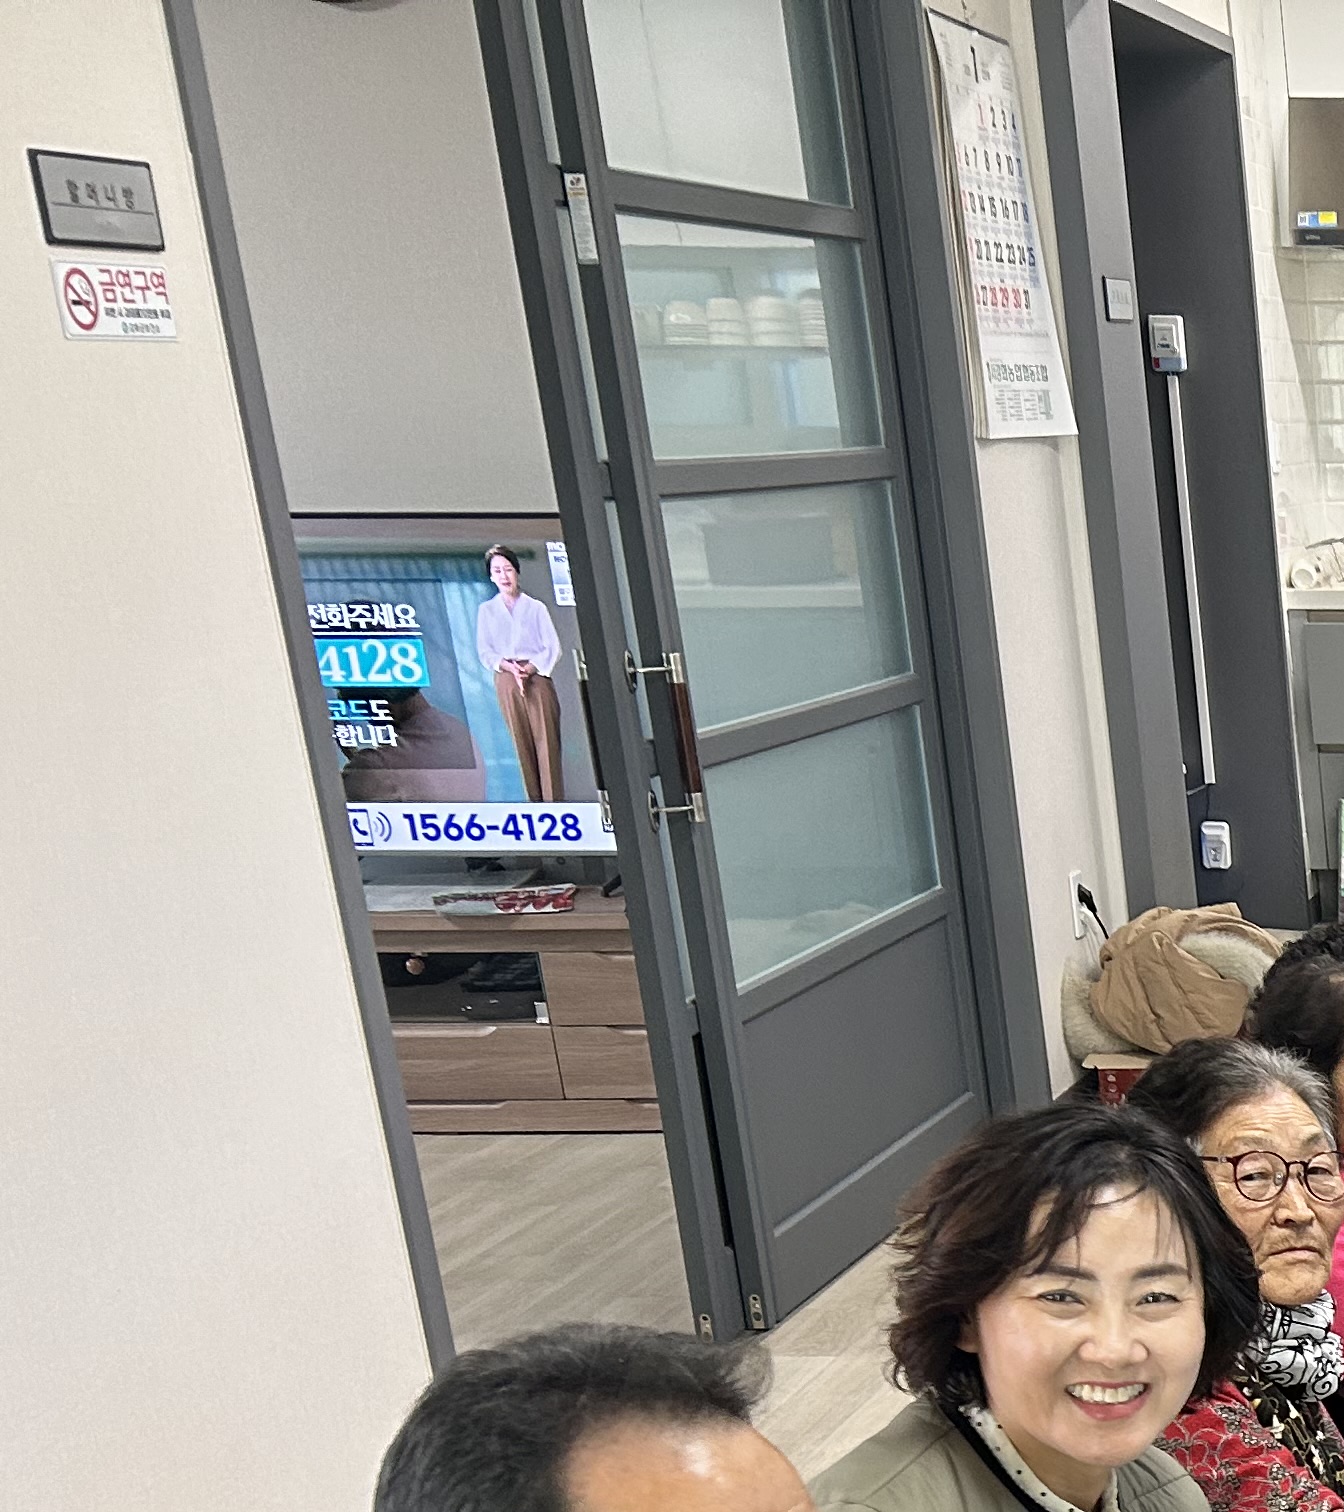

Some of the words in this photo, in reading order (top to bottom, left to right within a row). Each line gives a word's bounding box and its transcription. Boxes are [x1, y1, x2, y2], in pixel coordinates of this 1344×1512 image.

[98, 268, 170, 305] 금연구역
[307, 603, 421, 629] 전화주세요
[318, 638, 423, 684] 4128
[332, 724, 398, 747] 합니다
[402, 812, 583, 842] 1566-4128
